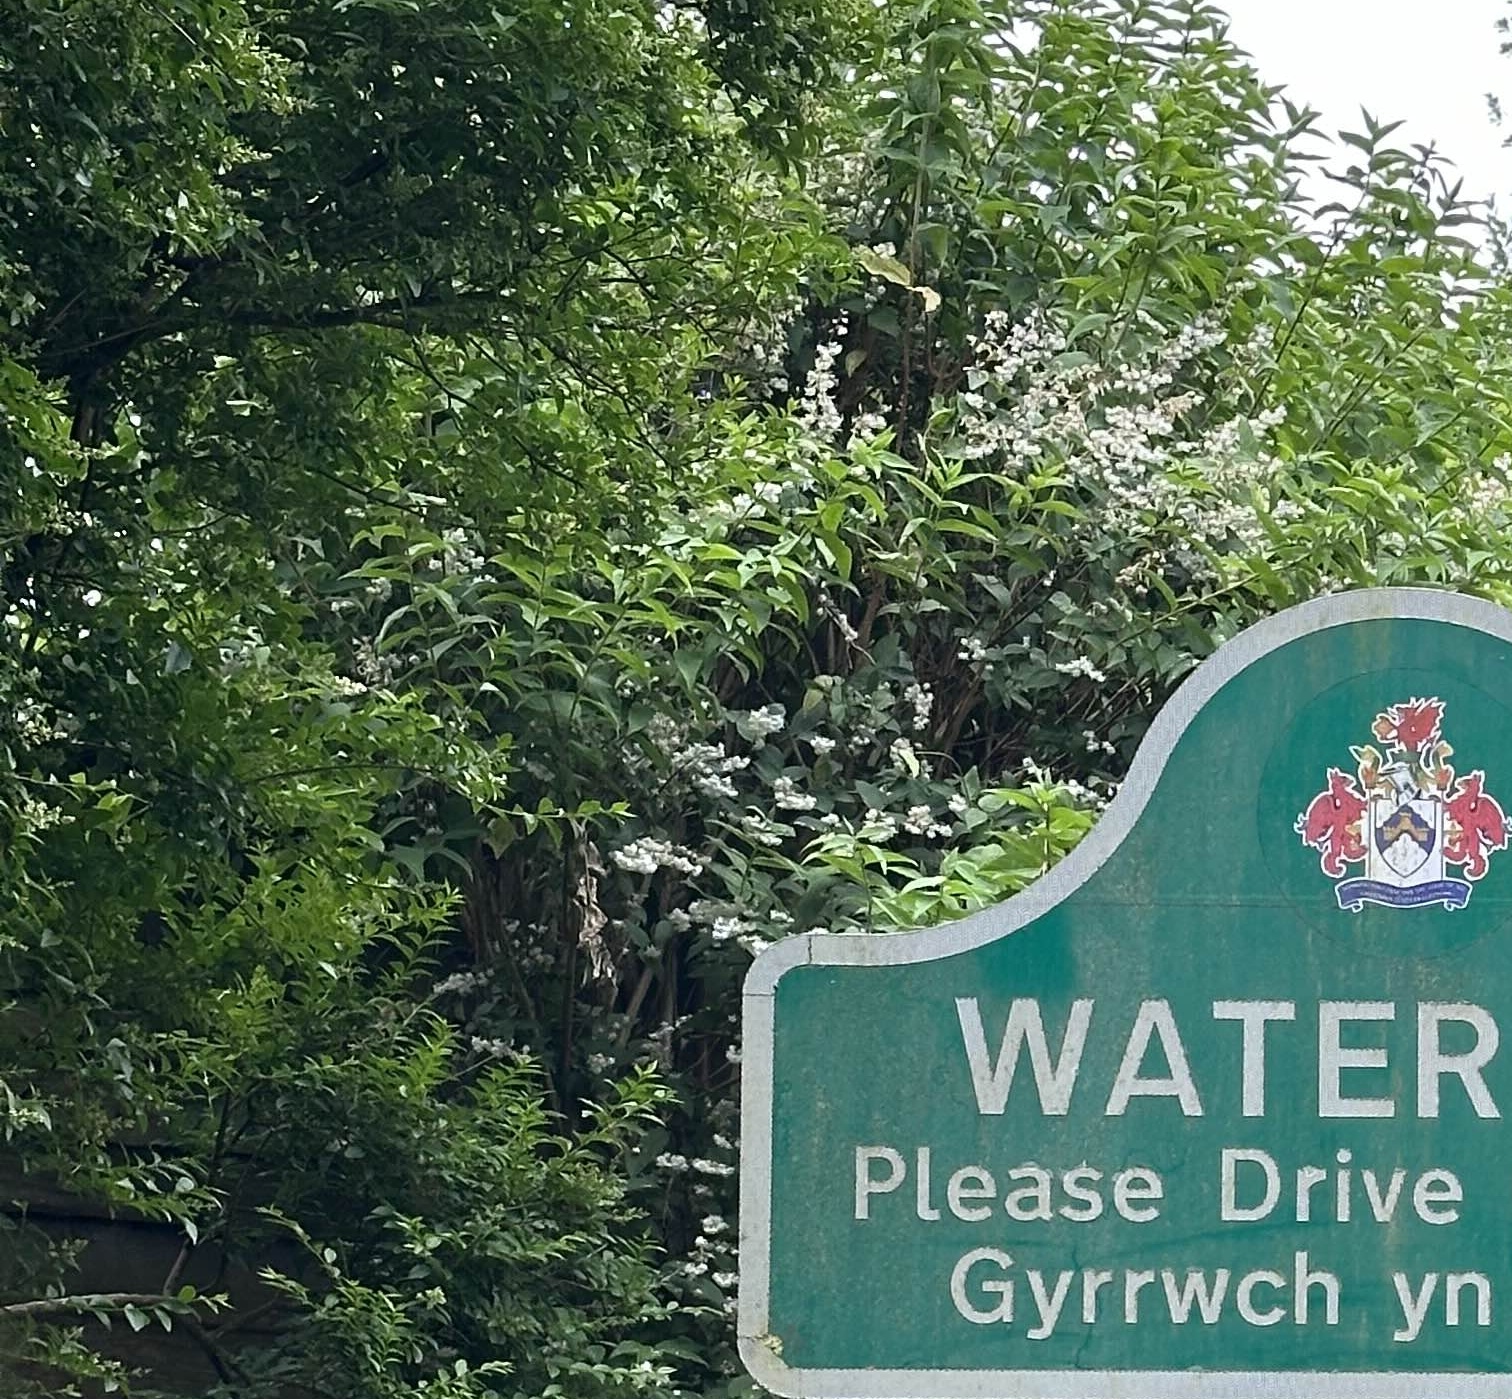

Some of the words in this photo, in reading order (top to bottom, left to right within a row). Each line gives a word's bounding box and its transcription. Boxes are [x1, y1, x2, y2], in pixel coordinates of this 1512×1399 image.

[854, 1145, 1164, 1223] Please
[1220, 1148, 1463, 1225] Drive
[950, 1246, 1340, 1340] Gyrrwch
[1391, 1271, 1491, 1342] yn
